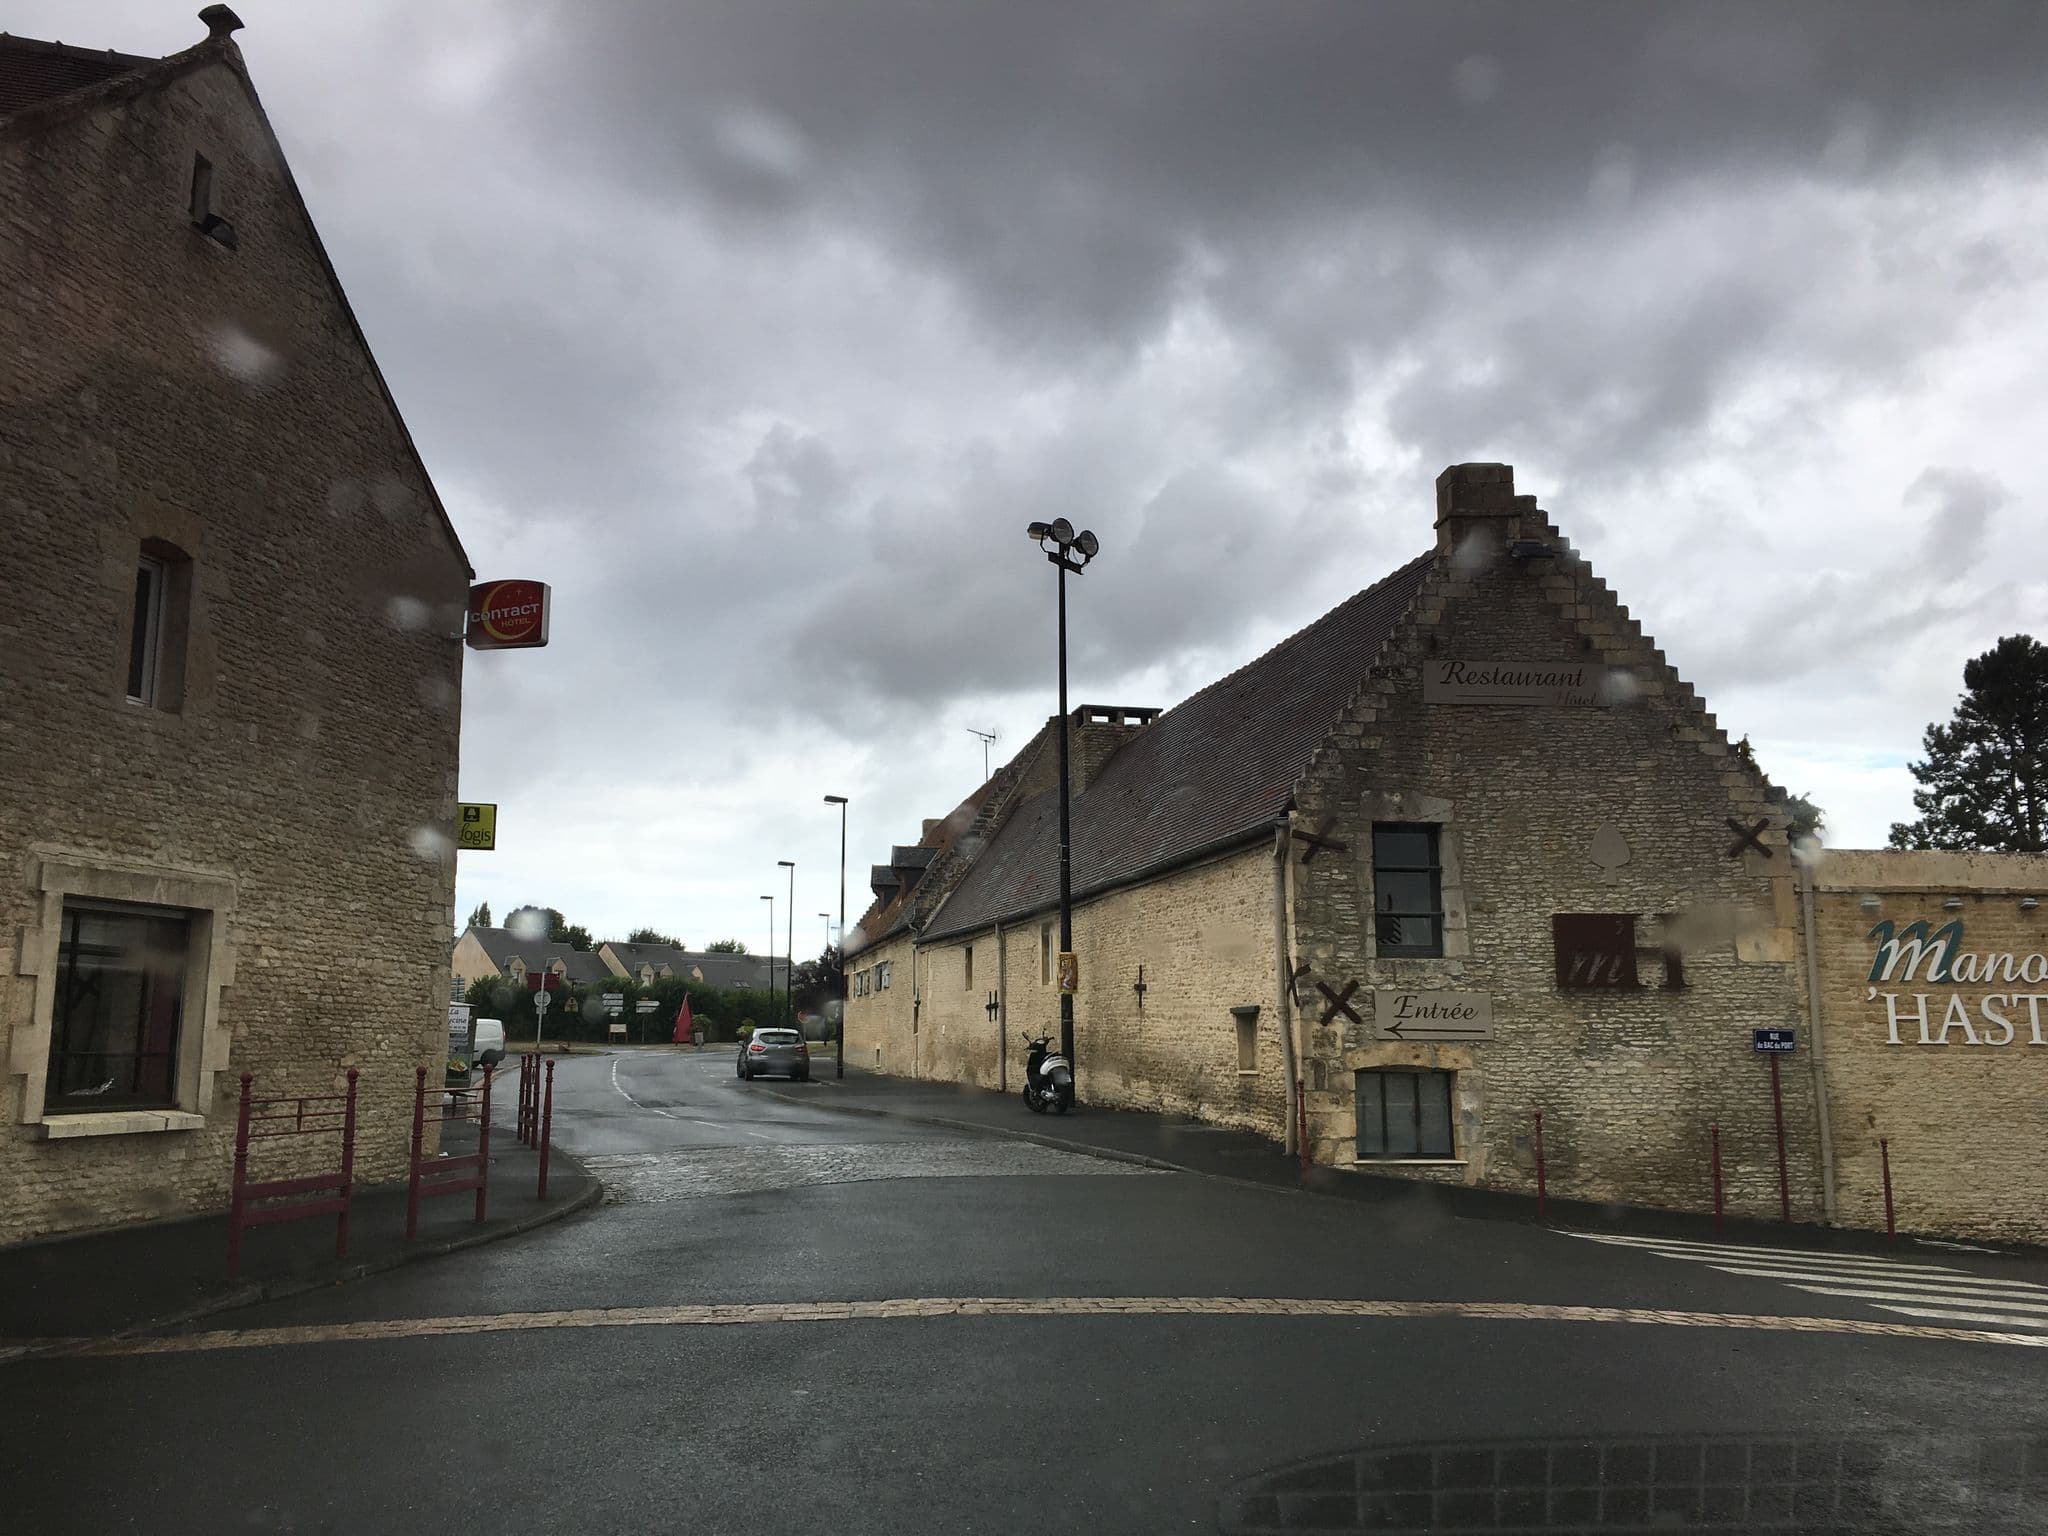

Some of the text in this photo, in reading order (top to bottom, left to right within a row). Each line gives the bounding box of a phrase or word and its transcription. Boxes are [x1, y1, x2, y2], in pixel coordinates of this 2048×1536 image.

[1440, 660, 1587, 687] Restaurant
[1393, 995, 1479, 1021] Entrée
[1764, 1041, 1774, 1049] BAC
[1781, 1041, 1794, 1049] PORT
